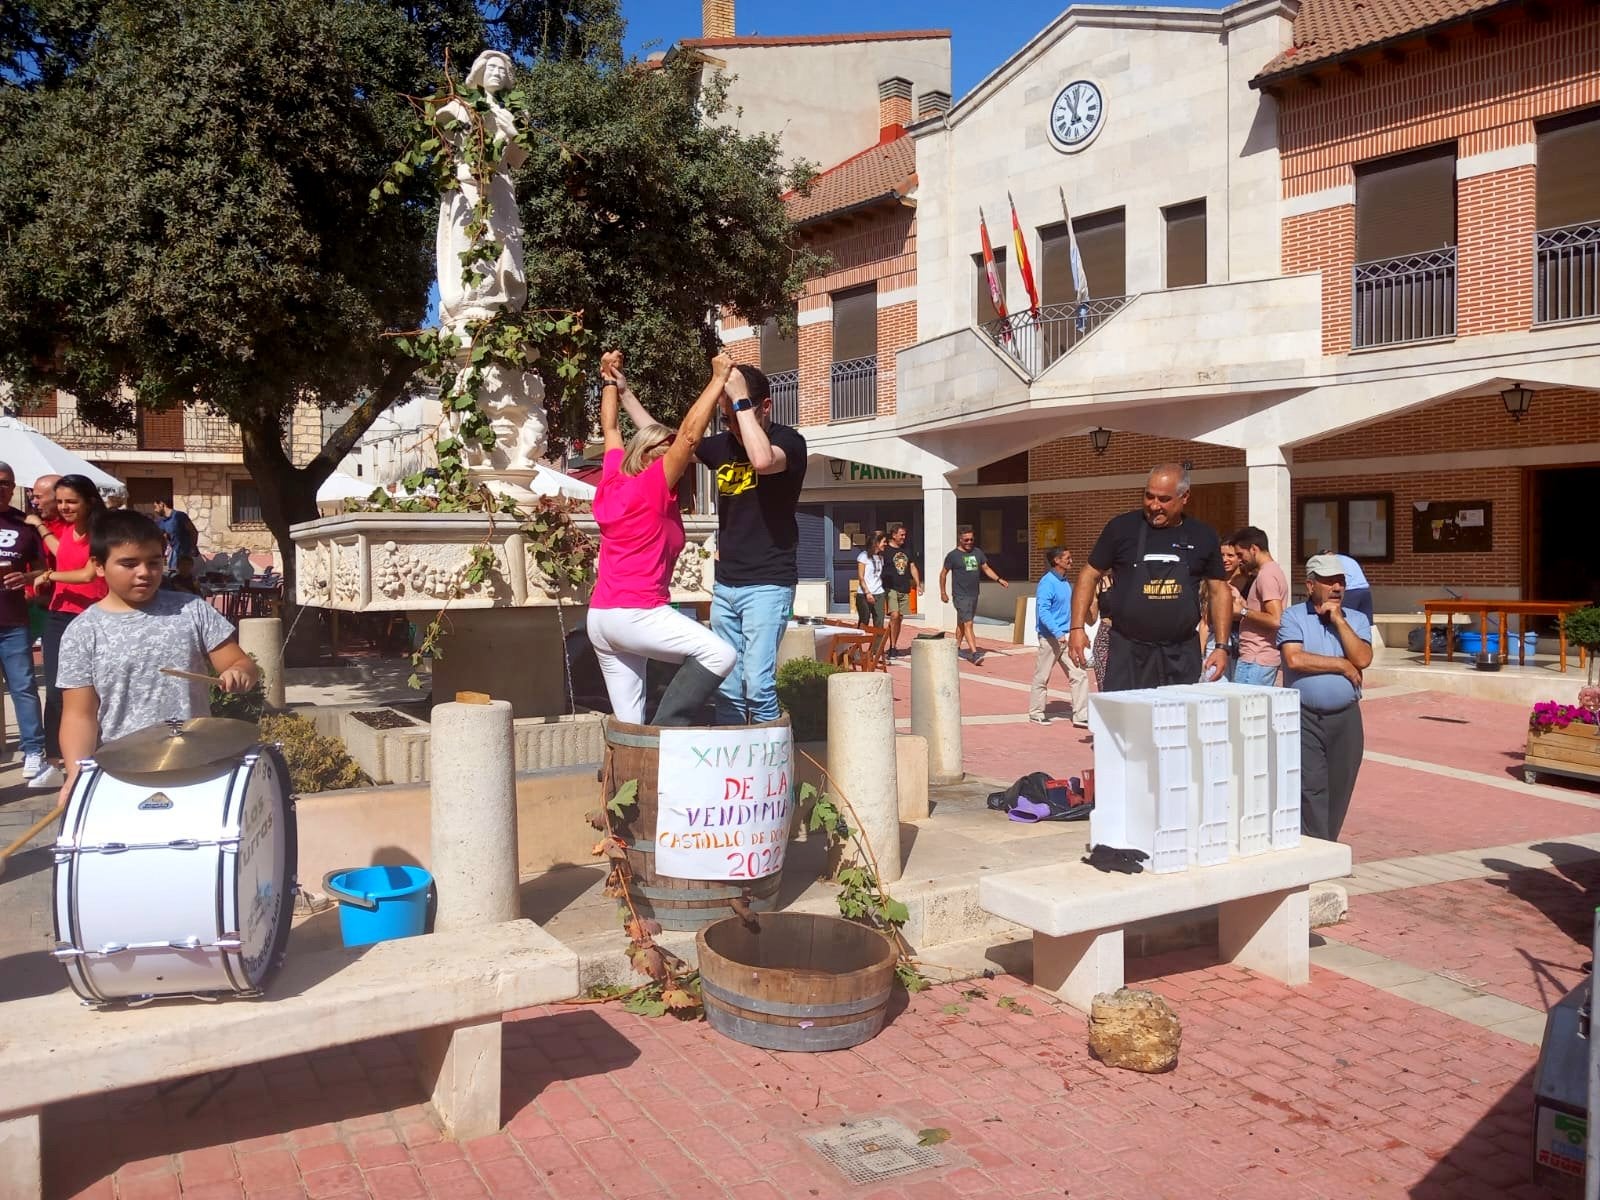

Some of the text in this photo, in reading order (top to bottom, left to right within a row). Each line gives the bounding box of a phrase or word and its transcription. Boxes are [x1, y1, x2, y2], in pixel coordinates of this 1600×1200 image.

[851, 461, 922, 480] FARM
[691, 740, 788, 768] XIV FIES
[724, 771, 788, 800] DE LA
[686, 799, 788, 827] VENDIMIA
[752, 831, 765, 845] DE
[727, 845, 781, 878] 2022
